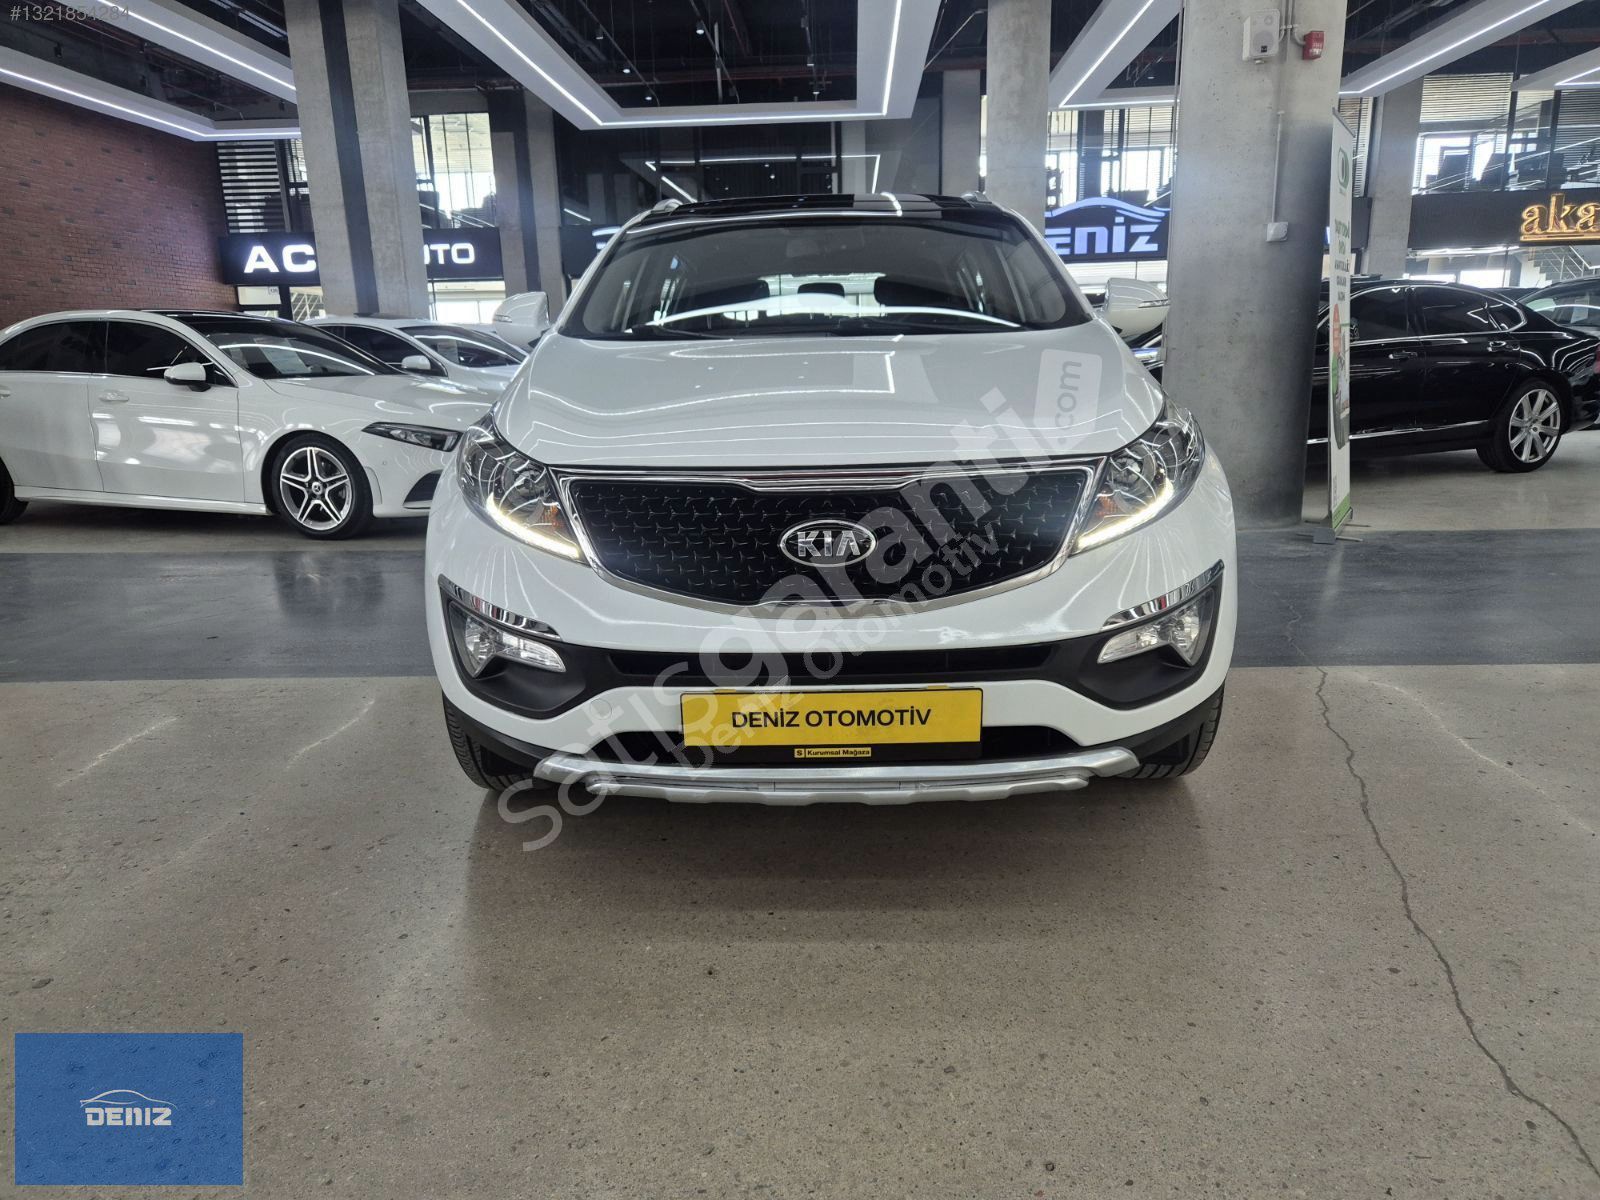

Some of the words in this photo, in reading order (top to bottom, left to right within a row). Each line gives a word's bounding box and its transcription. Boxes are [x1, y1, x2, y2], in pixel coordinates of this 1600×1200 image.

[797, 530, 860, 557] KIA
[732, 708, 800, 728] DENİZ
[805, 705, 932, 728] OTOMOTİV
[842, 749, 870, 757] Mağaza
